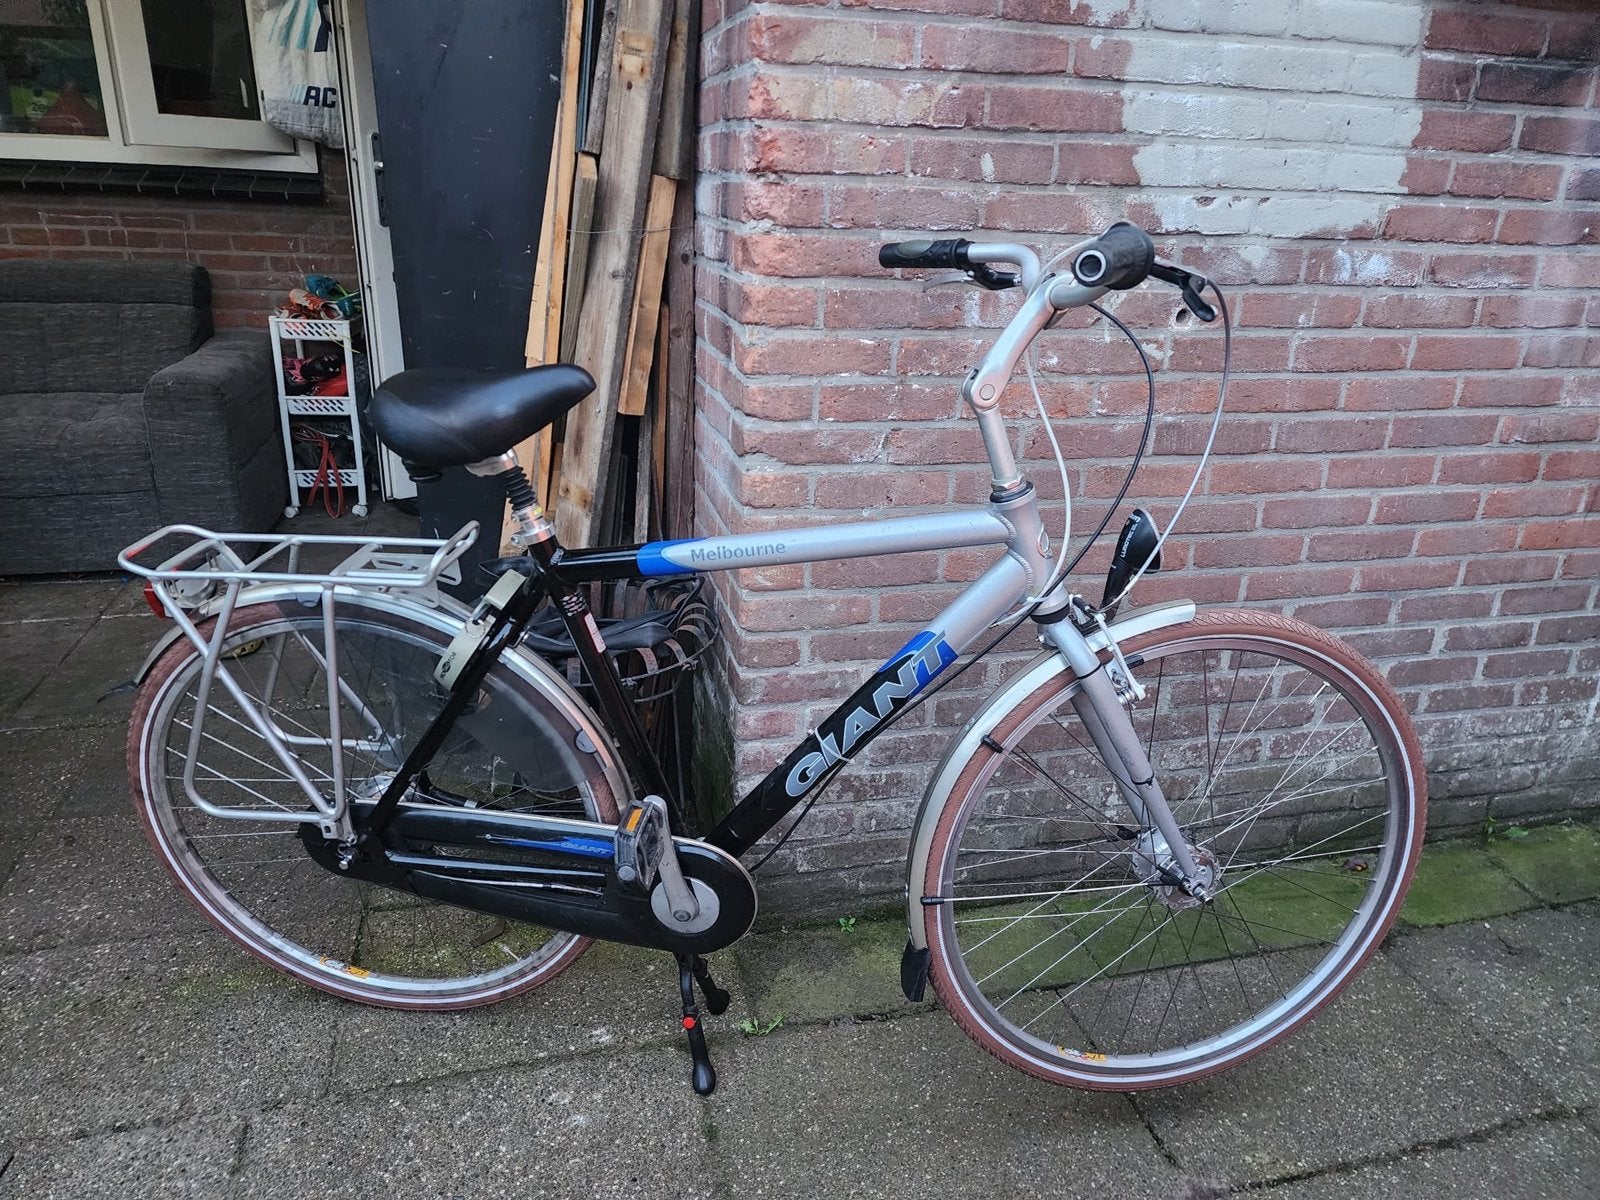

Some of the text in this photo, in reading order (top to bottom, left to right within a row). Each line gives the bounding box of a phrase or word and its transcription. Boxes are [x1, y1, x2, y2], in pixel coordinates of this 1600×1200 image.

[690, 542, 786, 562] Melbourne
[785, 631, 946, 797] GIANT
[561, 842, 610, 854] GIANT
